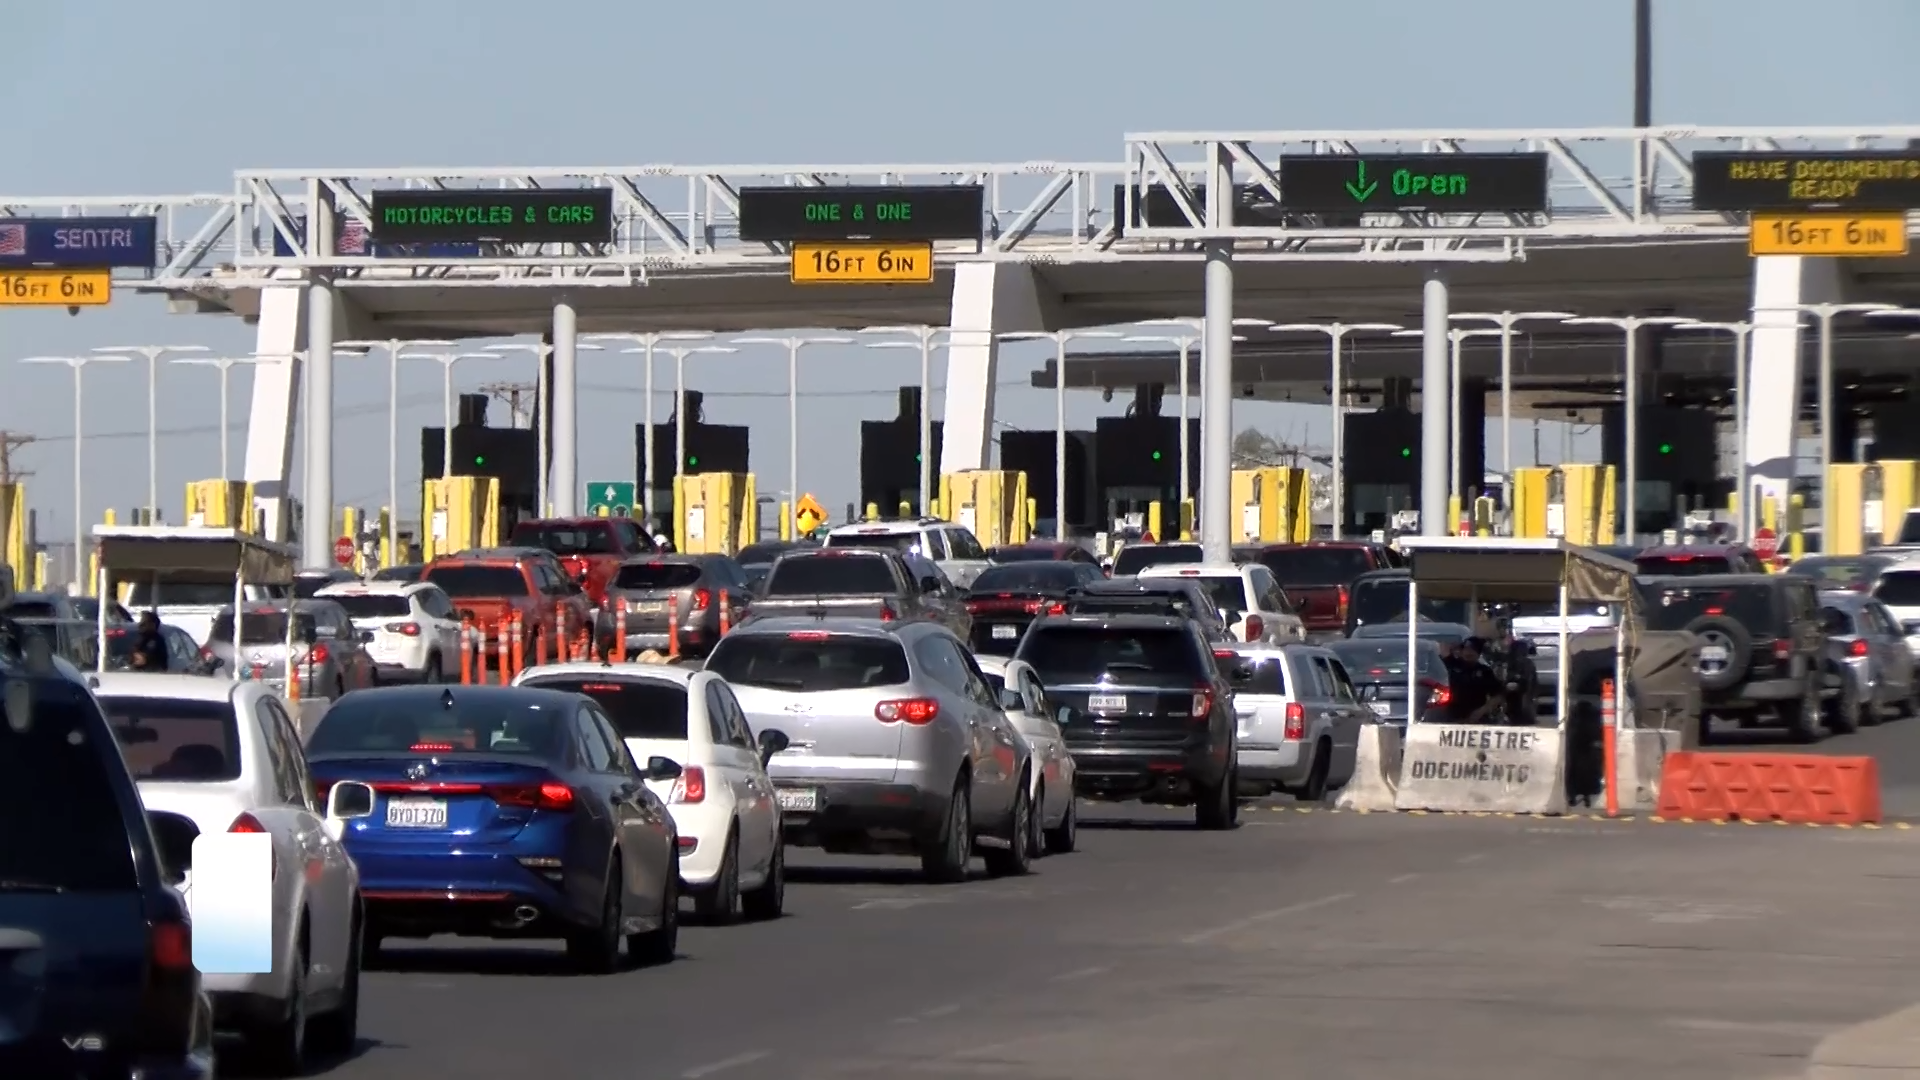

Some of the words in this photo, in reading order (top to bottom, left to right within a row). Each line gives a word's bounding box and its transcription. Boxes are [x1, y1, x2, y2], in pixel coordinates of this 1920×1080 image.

[1730, 160, 1787, 179] HAVE
[1793, 160, 1920, 179] DOCUMENTS
[1391, 168, 1467, 196] Open
[1789, 180, 1861, 199] READY
[385, 206, 513, 224] MOTORCYCLES
[525, 206, 536, 223] &
[548, 205, 594, 223] CARS
[805, 203, 841, 220] ONE
[853, 203, 864, 220] &
[877, 203, 912, 220] ONE
[53, 228, 132, 249] SENTRI
